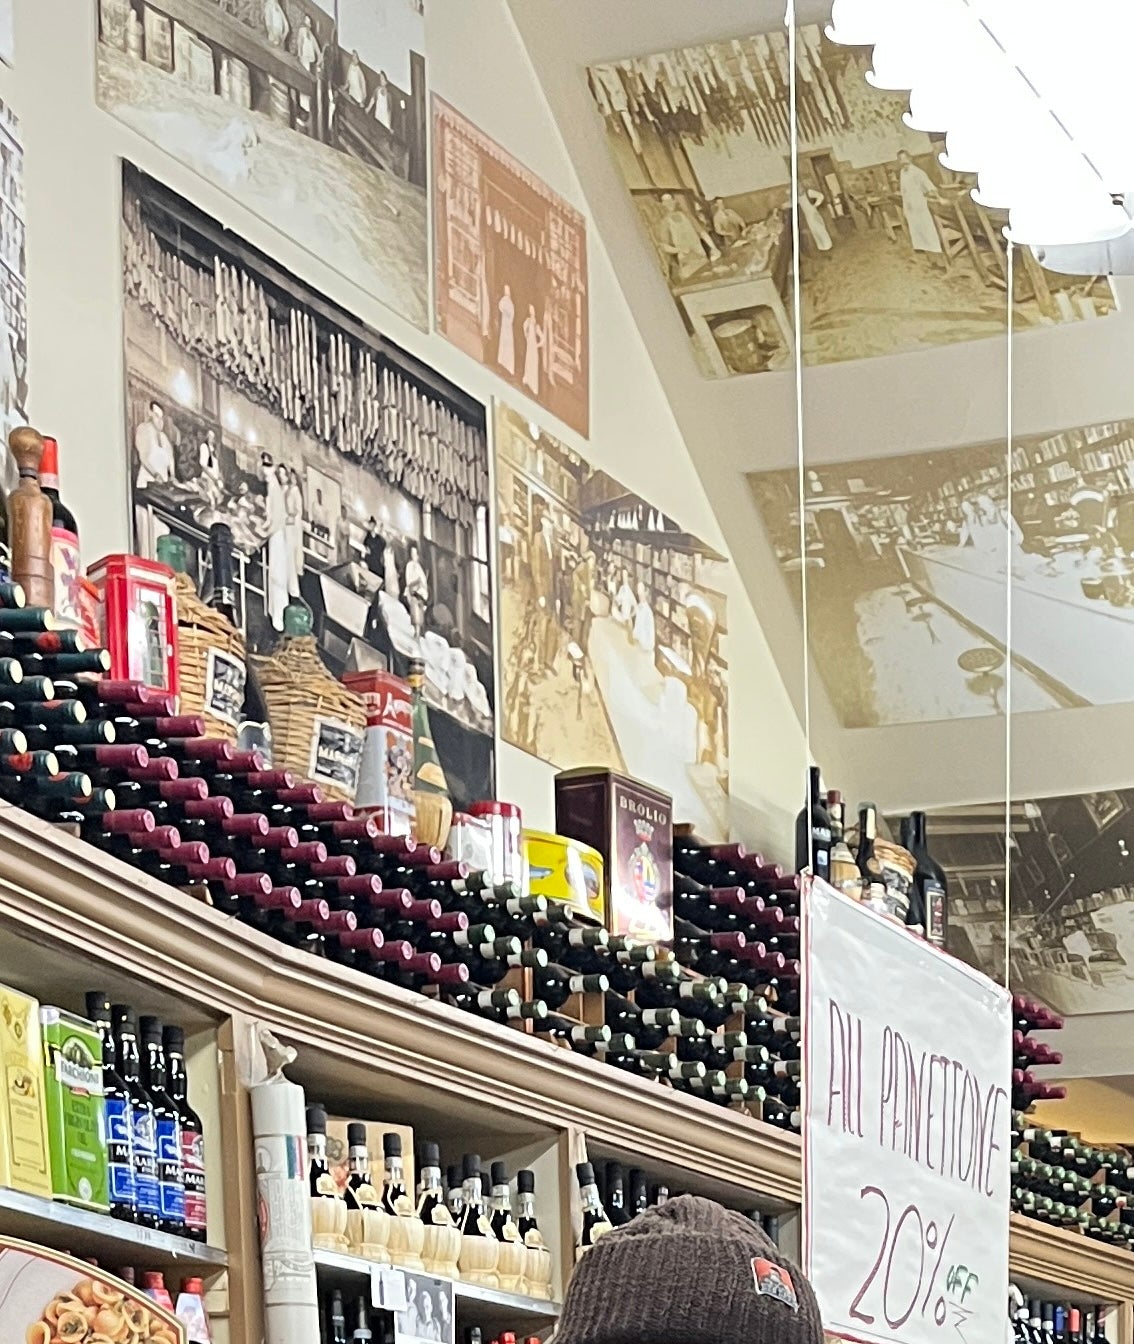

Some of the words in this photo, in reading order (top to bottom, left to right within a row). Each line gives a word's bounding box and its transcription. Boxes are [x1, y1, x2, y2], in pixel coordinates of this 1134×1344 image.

[880, 1024, 1008, 1197] PANETTONE
[848, 1185, 956, 1330] 20%
[946, 1263, 980, 1305] OFF
